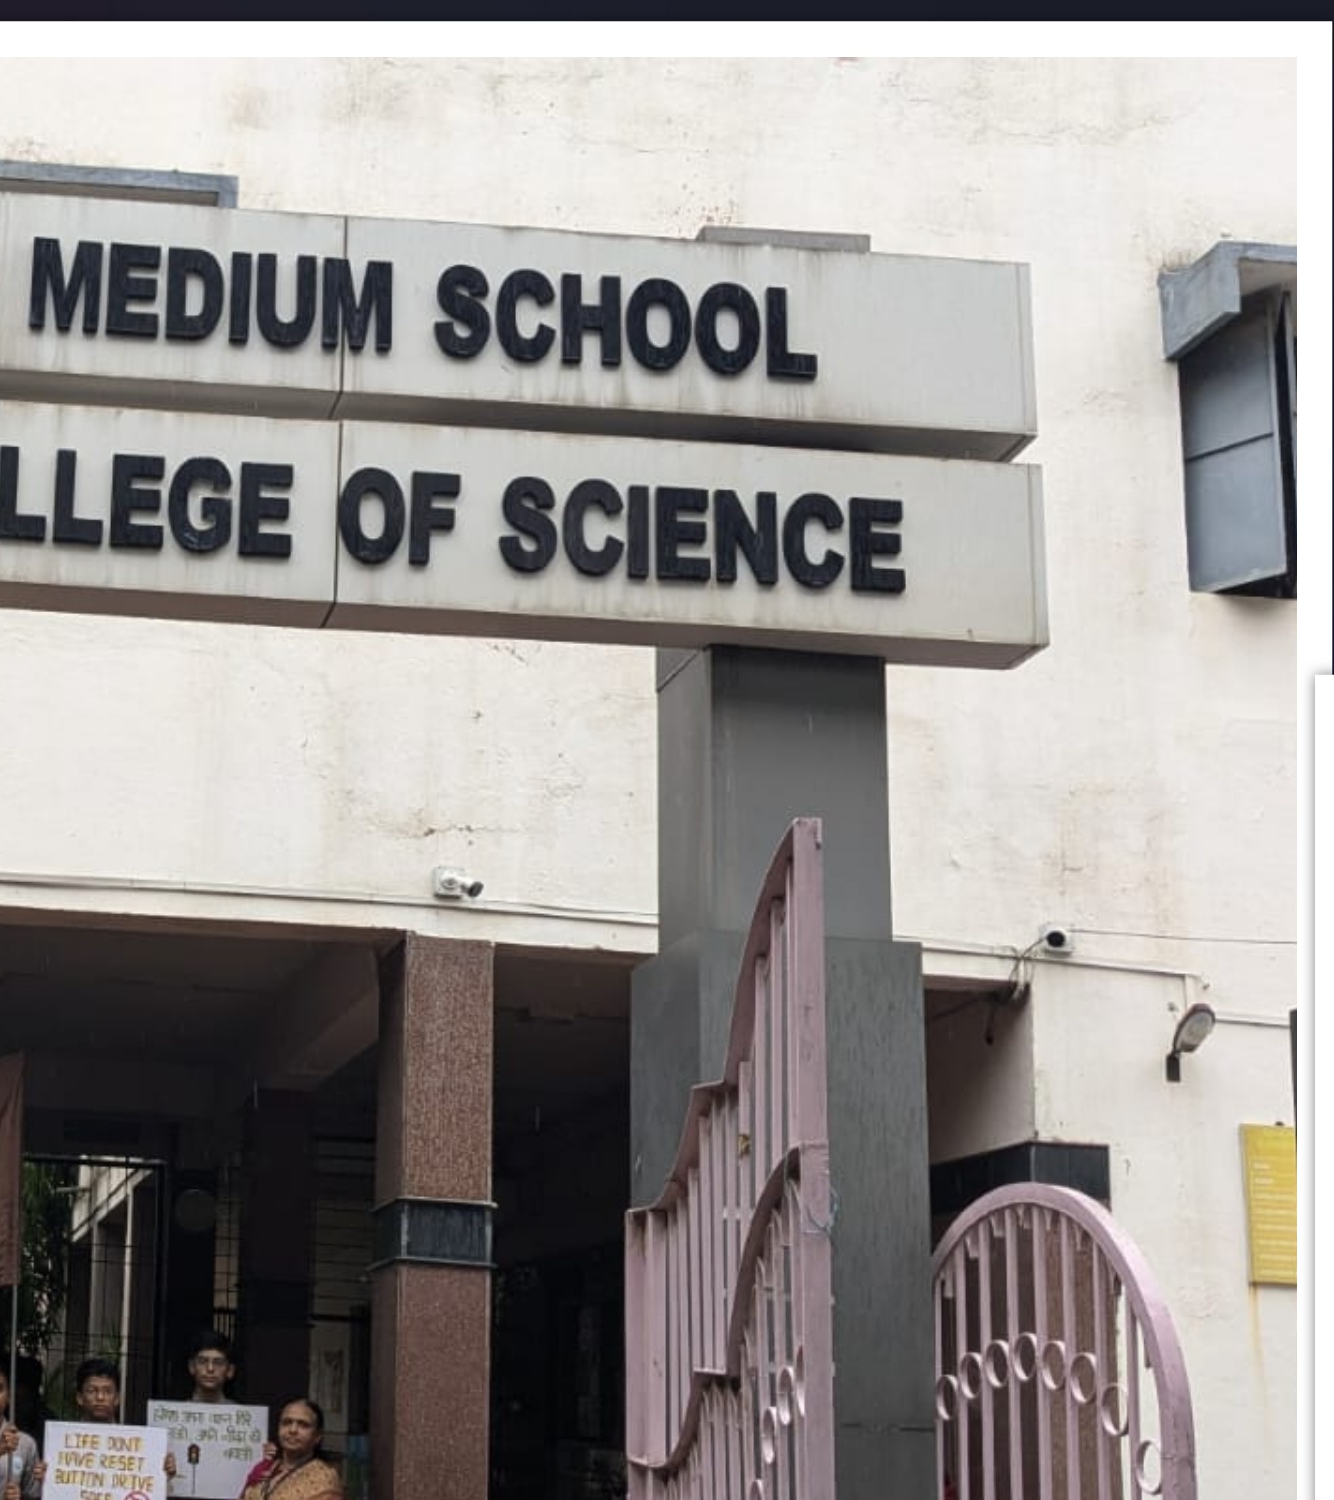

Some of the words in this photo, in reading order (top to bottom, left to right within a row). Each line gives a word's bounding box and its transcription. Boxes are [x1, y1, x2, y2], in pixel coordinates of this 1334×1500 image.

[29, 235, 393, 353] MEDIUM
[433, 264, 818, 380] SCHOOL
[338, 467, 461, 567] OF
[498, 476, 907, 595] SCIENCE
[64, 1432, 99, 1450] LIFE
[58, 1451, 95, 1469] HAVE
[99, 1453, 147, 1472] RESET
[54, 1468, 104, 1488] BUTTON
[111, 1471, 155, 1493] DRIVE
